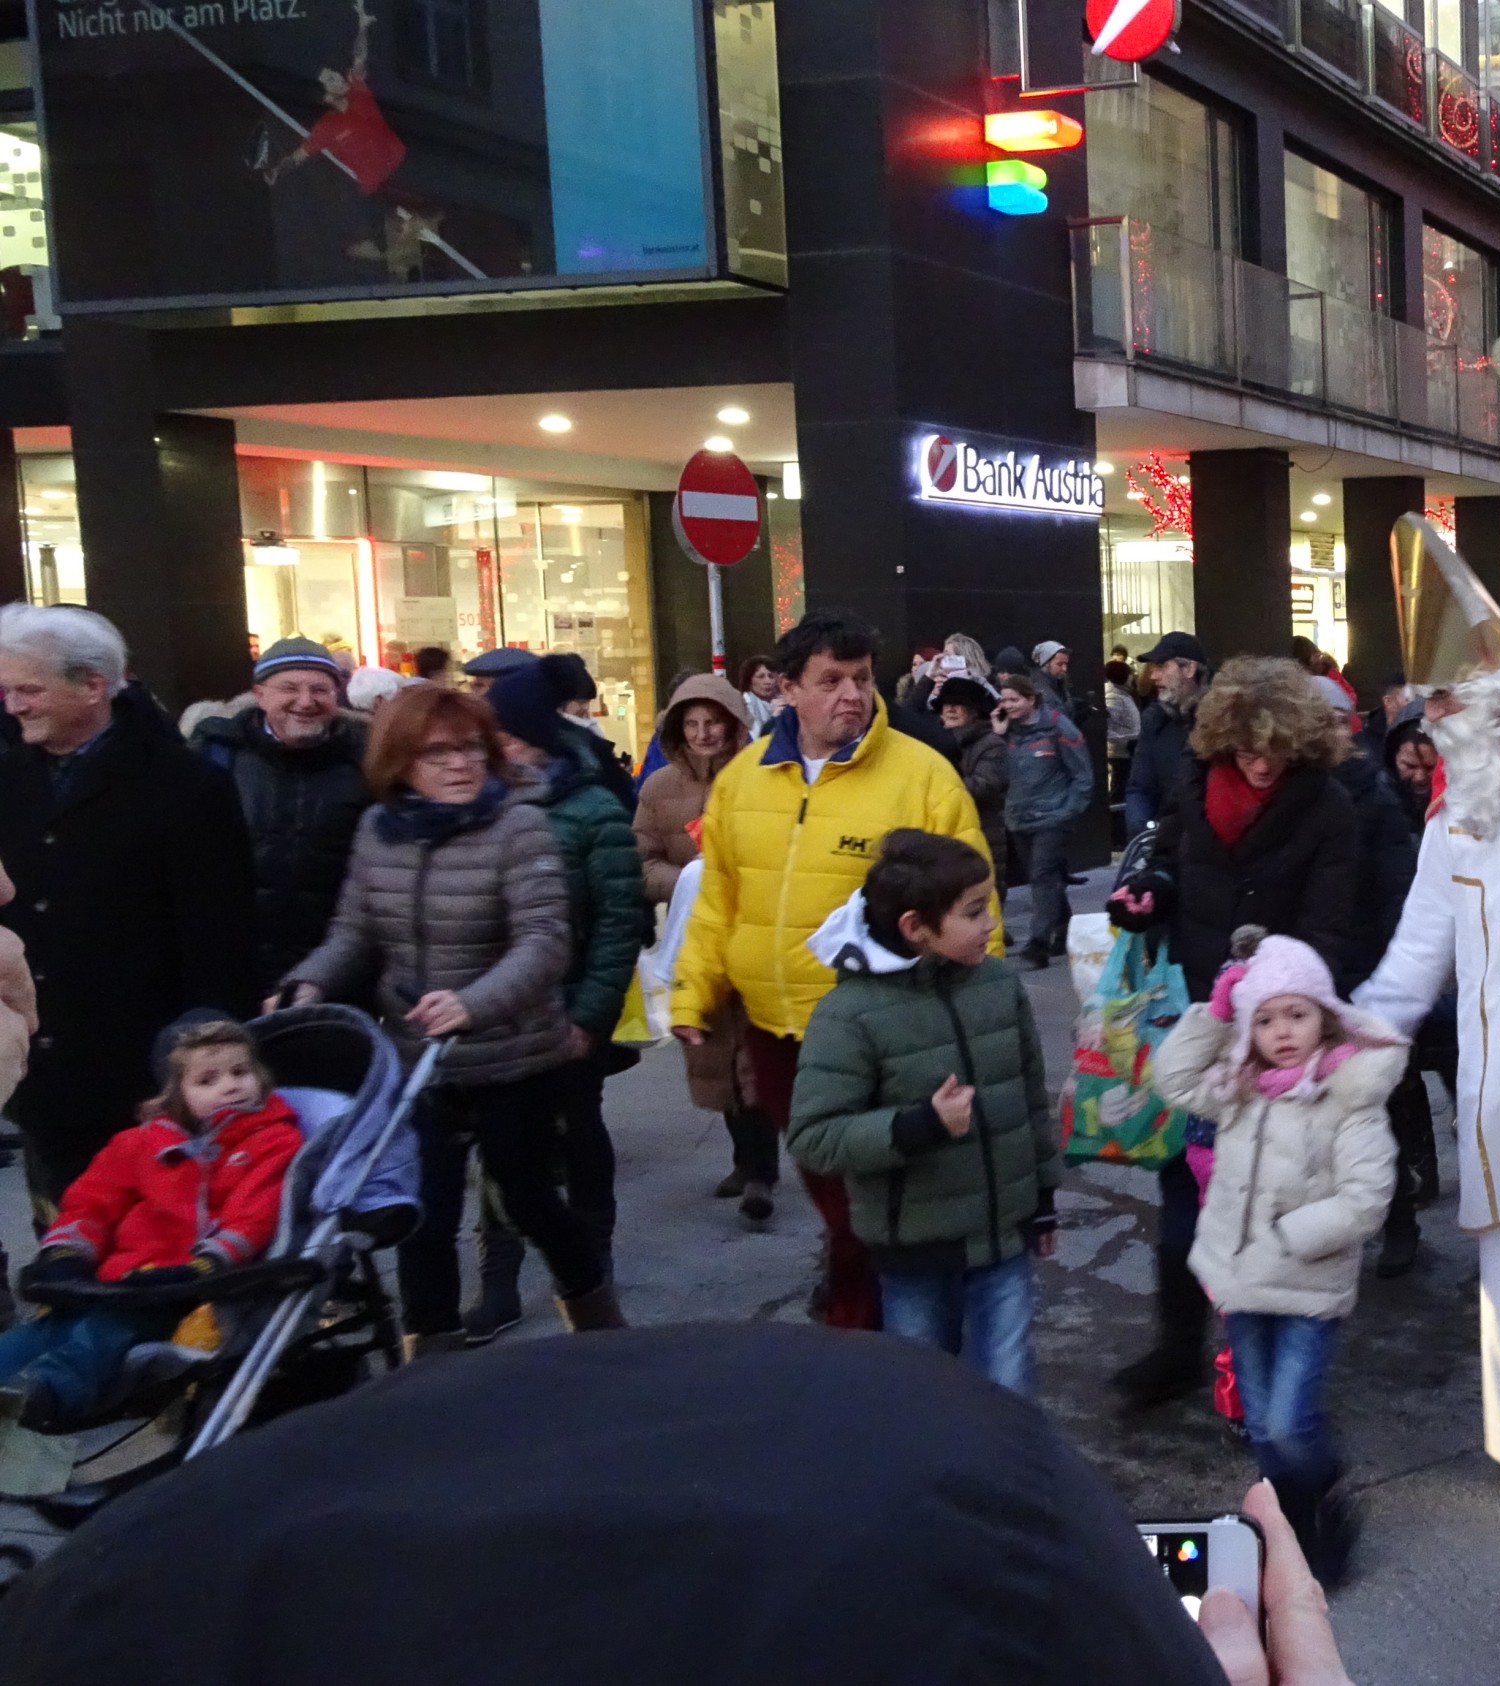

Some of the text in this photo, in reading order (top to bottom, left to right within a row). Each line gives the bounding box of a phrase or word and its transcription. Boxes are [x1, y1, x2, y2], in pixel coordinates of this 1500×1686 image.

[58, 7, 126, 39] Nicht
[184, 3, 224, 28] am
[233, 0, 307, 23] Platz.
[963, 444, 1105, 508] Bank Austria
[838, 835, 866, 853] HH
